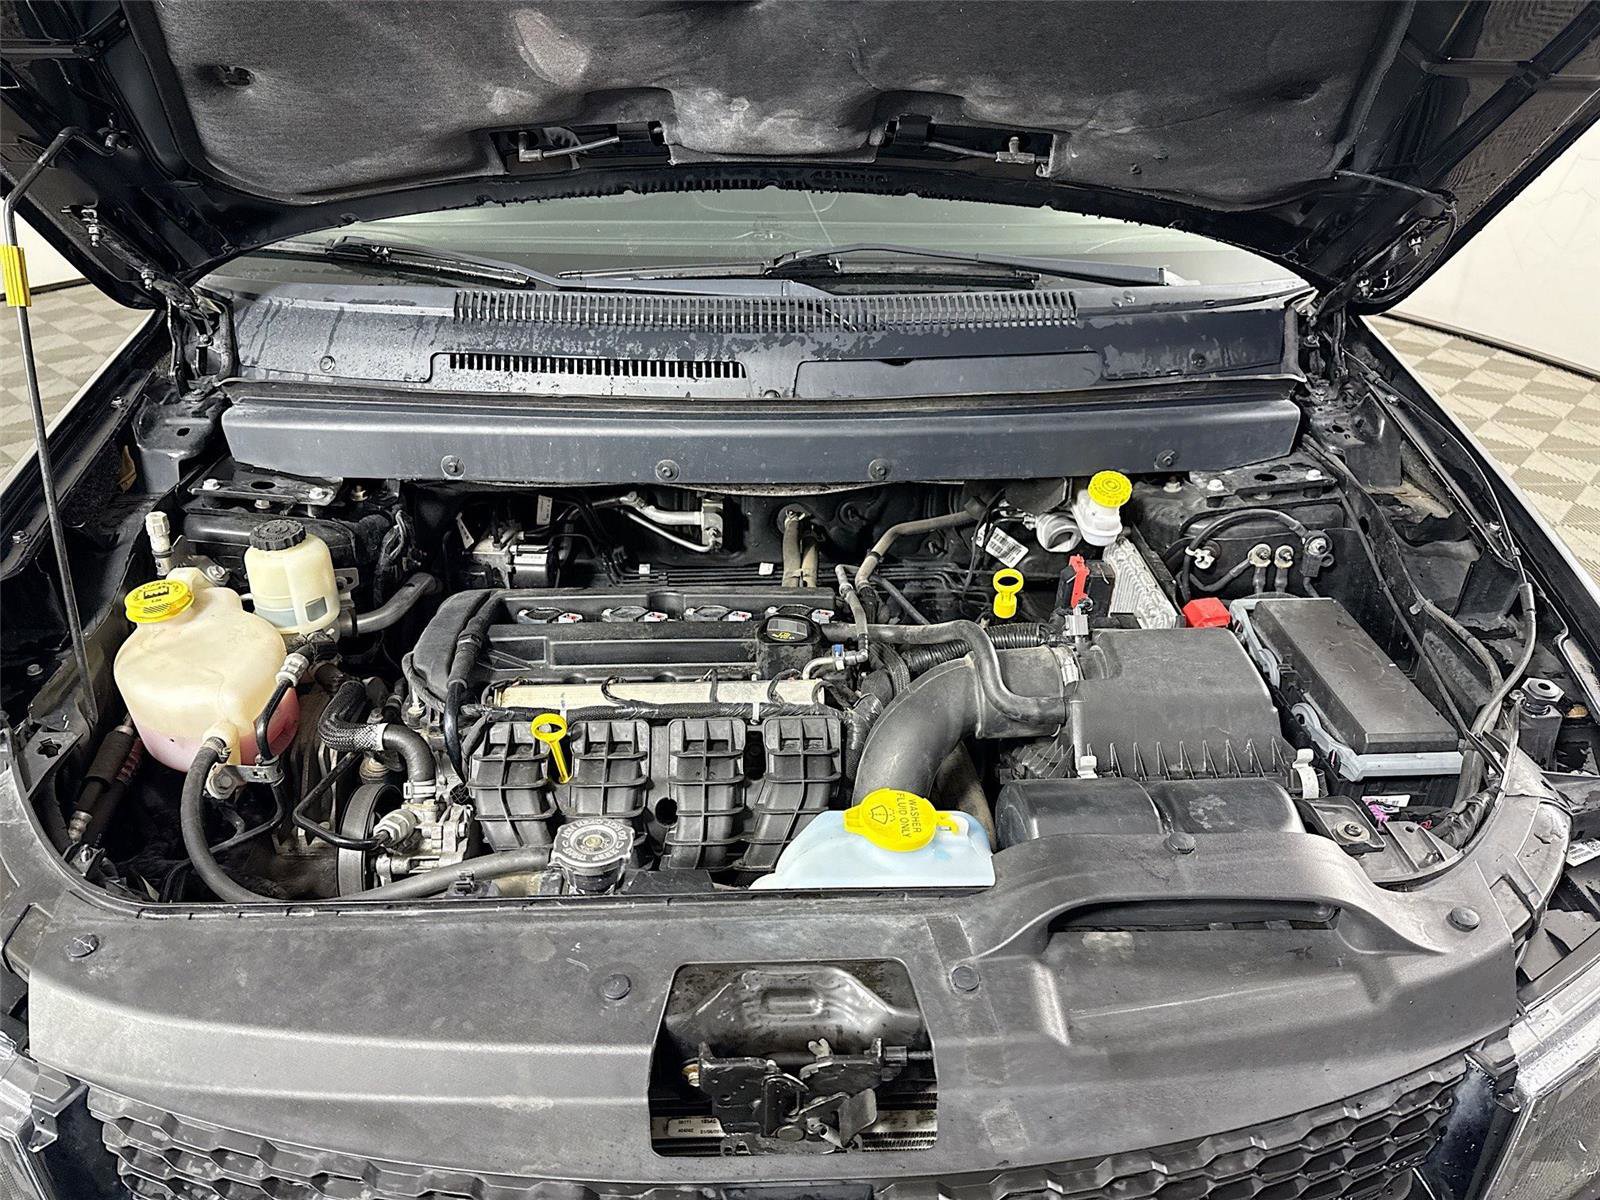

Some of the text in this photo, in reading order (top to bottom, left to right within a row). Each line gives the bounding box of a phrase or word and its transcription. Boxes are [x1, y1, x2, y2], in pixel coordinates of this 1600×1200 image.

[896, 792, 912, 838] FLUID ONLY
[909, 799, 922, 833] WASHER
